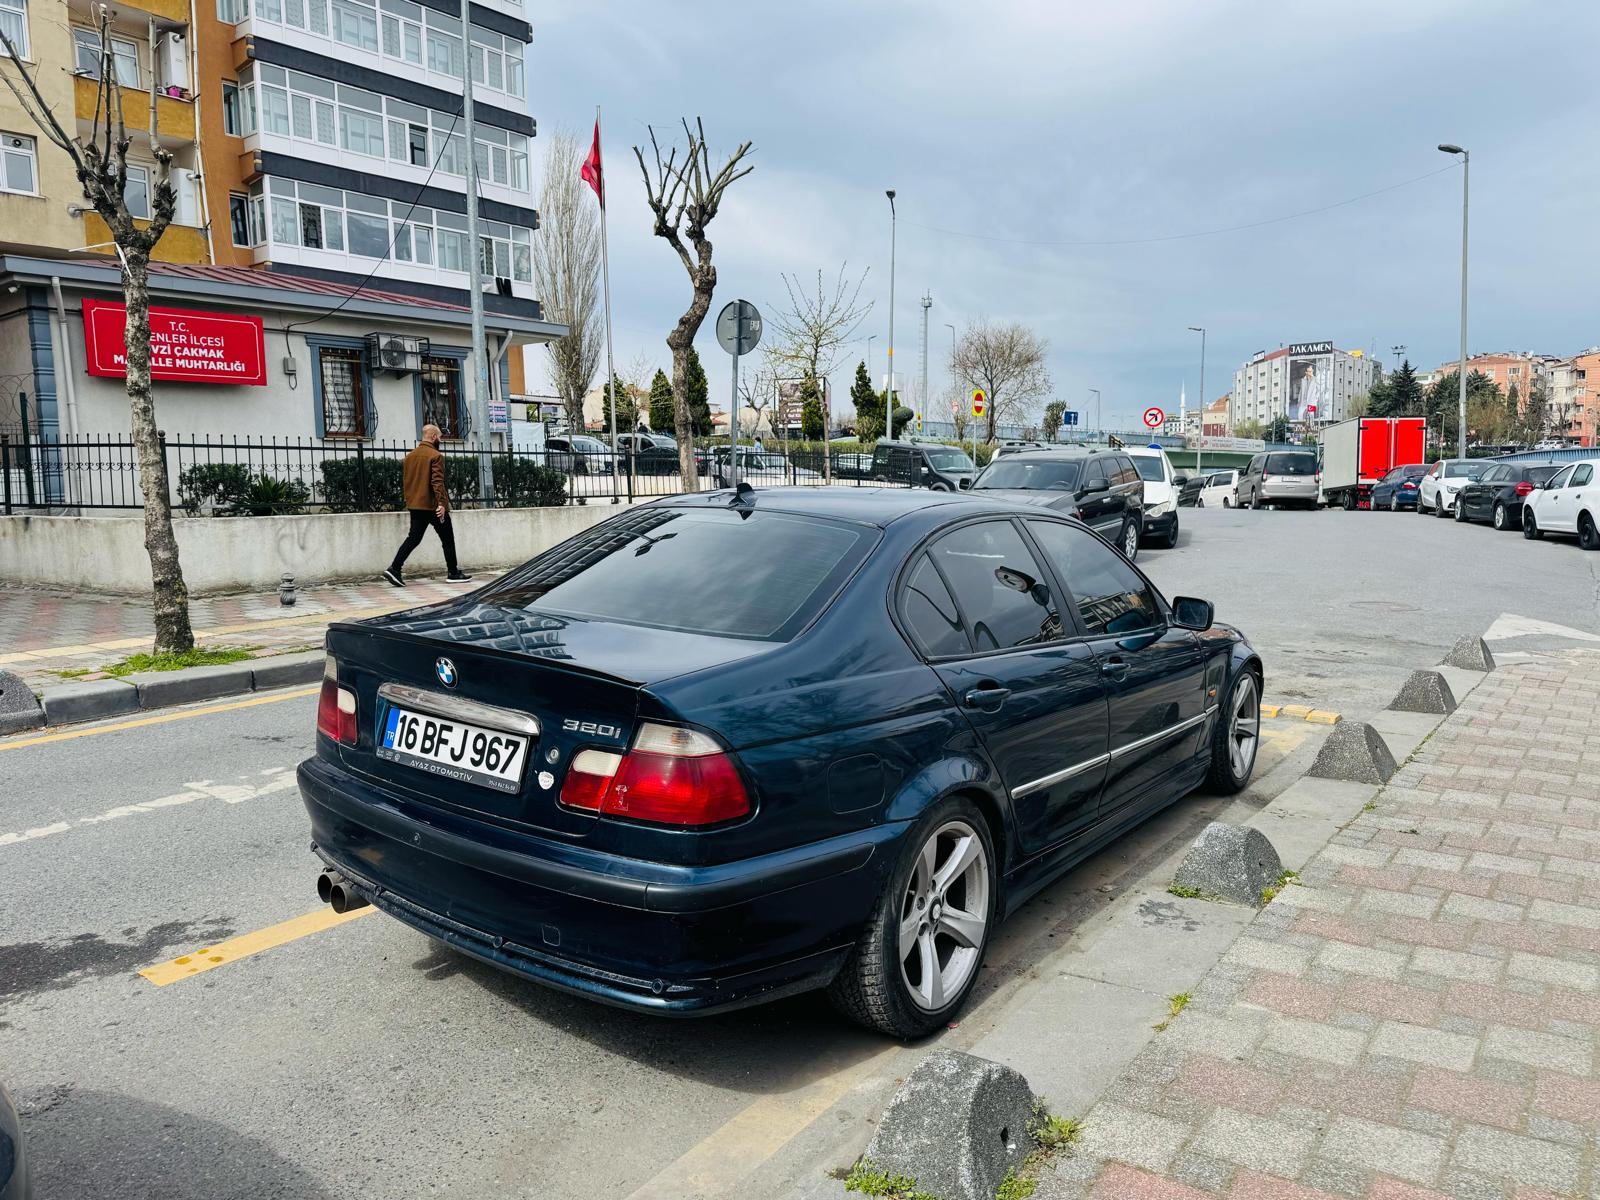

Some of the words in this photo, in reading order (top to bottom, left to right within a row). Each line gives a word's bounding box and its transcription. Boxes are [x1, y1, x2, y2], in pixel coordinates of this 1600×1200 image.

[169, 321, 190, 332] T.C.
[149, 332, 187, 344] ENLER
[190, 333, 225, 347] İLÇESİ
[150, 343, 171, 355] VZİ
[174, 346, 225, 359] ÇAKMAK
[1290, 343, 1332, 354] JAKAMEN
[113, 354, 173, 368] MLLE
[175, 358, 246, 372] MUHTARLIĞI
[386, 730, 395, 742] TR
[562, 718, 622, 739] 320i
[397, 714, 420, 750] 16
[420, 720, 469, 762] BFJ
[469, 732, 521, 775] 967
[409, 759, 430, 771] AYAZ
[430, 765, 473, 781] OTOMOTİV
